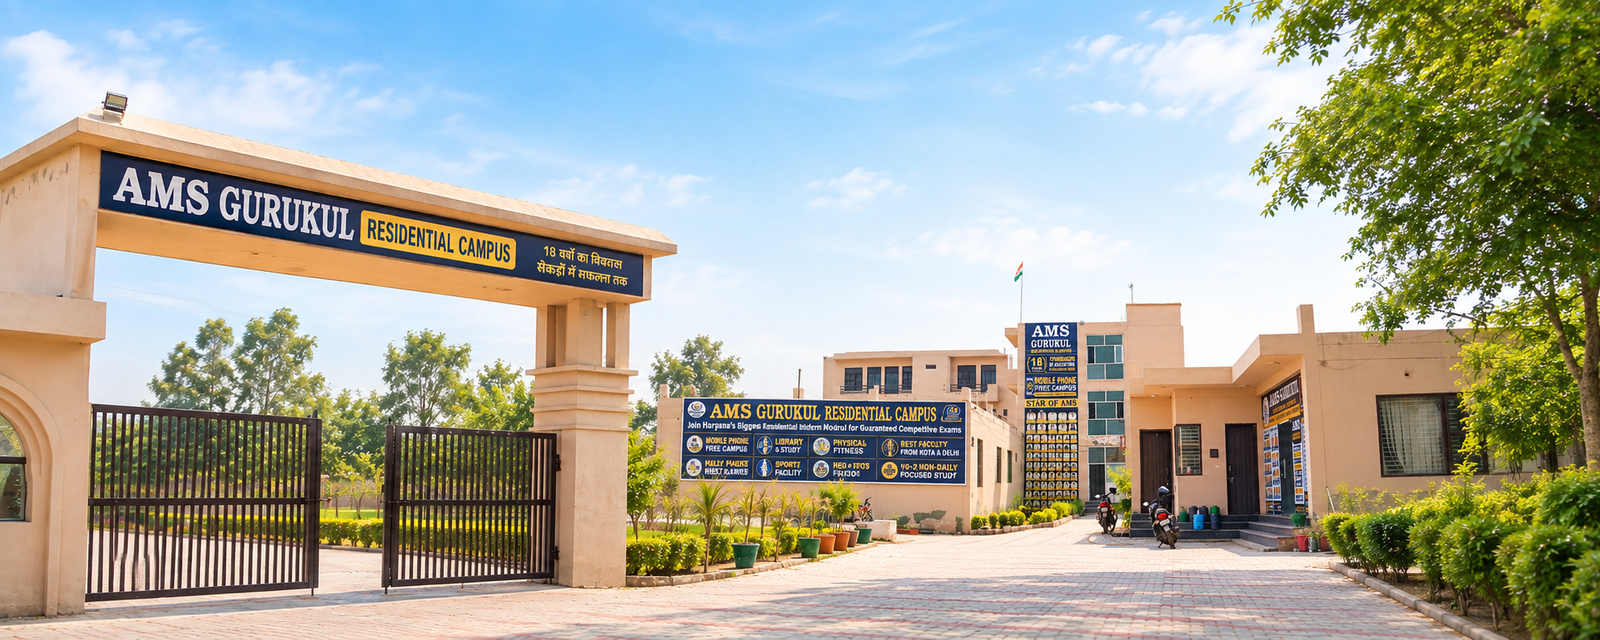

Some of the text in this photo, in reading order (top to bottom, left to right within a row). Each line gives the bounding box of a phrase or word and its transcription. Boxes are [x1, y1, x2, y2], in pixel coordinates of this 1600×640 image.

[112, 166, 355, 241] AMS GURUKUL
[367, 218, 511, 263] RESIDENTIAL CAMPUS
[543, 245, 556, 257] 18
[577, 252, 589, 264] का
[567, 264, 577, 278] में
[1031, 324, 1070, 338] AMS
[1031, 339, 1071, 348] GURUKUL
[1031, 357, 1043, 367] 18
[1026, 399, 1077, 407] STAR OF AMS
[709, 403, 752, 419] AMS
[756, 404, 821, 420] GURUKUL
[824, 405, 893, 422] RESIDENTIAL
[895, 406, 937, 422] CAMPUS
[687, 421, 701, 429] Join
[848, 424, 859, 432] for
[900, 440, 917, 448] BEST
